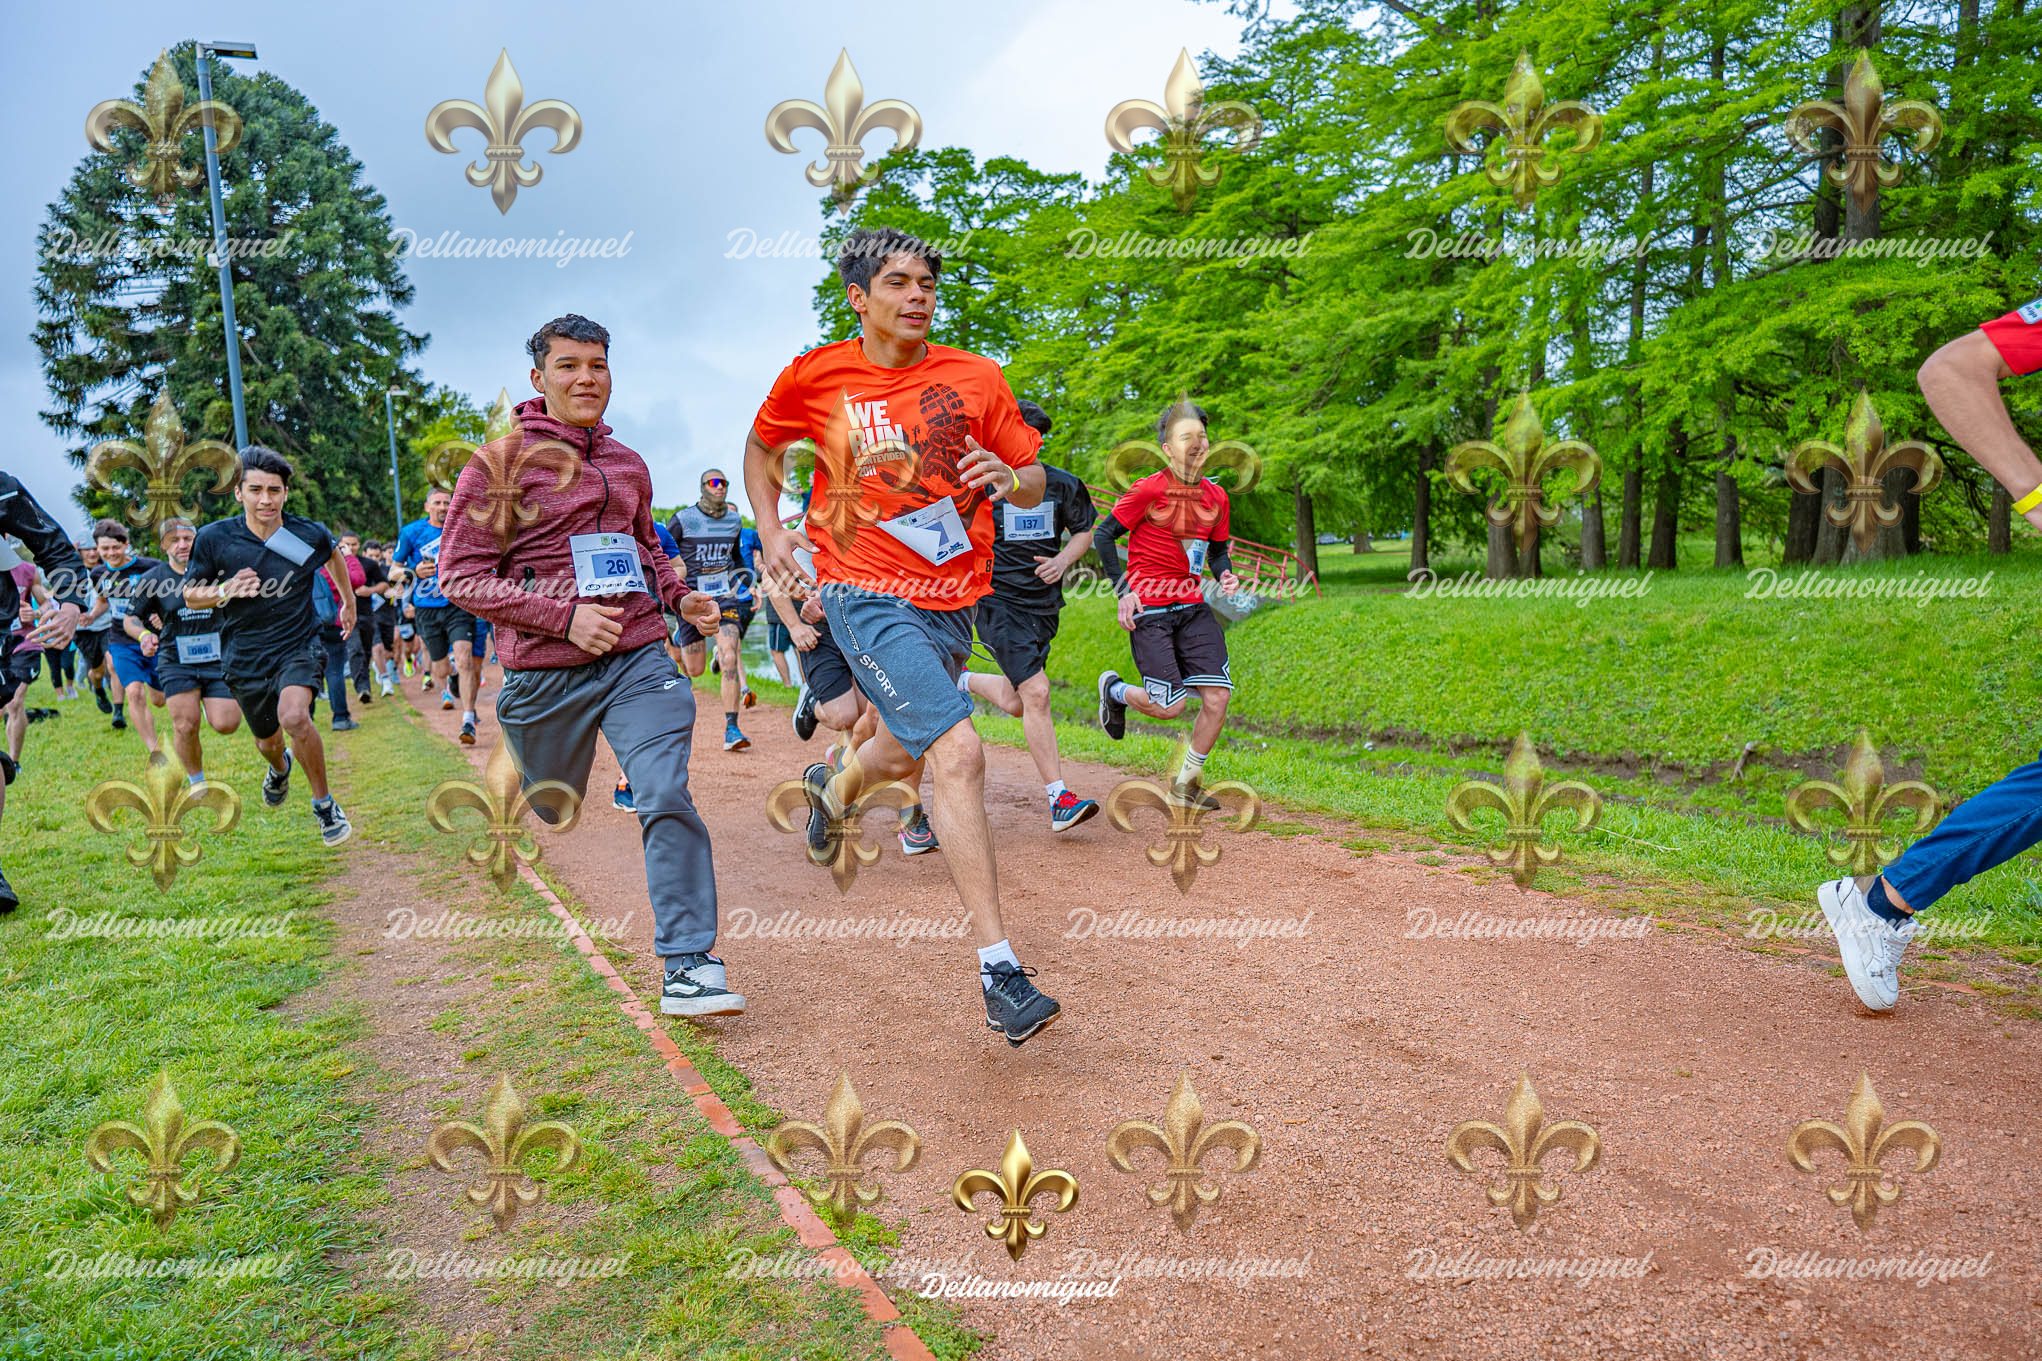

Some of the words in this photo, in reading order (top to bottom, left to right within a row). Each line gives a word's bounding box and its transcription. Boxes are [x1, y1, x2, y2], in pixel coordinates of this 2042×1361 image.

[844, 400, 890, 429] WE
[847, 424, 906, 457] RUN
[854, 451, 906, 467] MONTEVIDEO
[858, 465, 877, 478] 2011
[1022, 519, 1038, 529] 137
[606, 559, 630, 575] 261
[859, 654, 898, 698] SPORT
